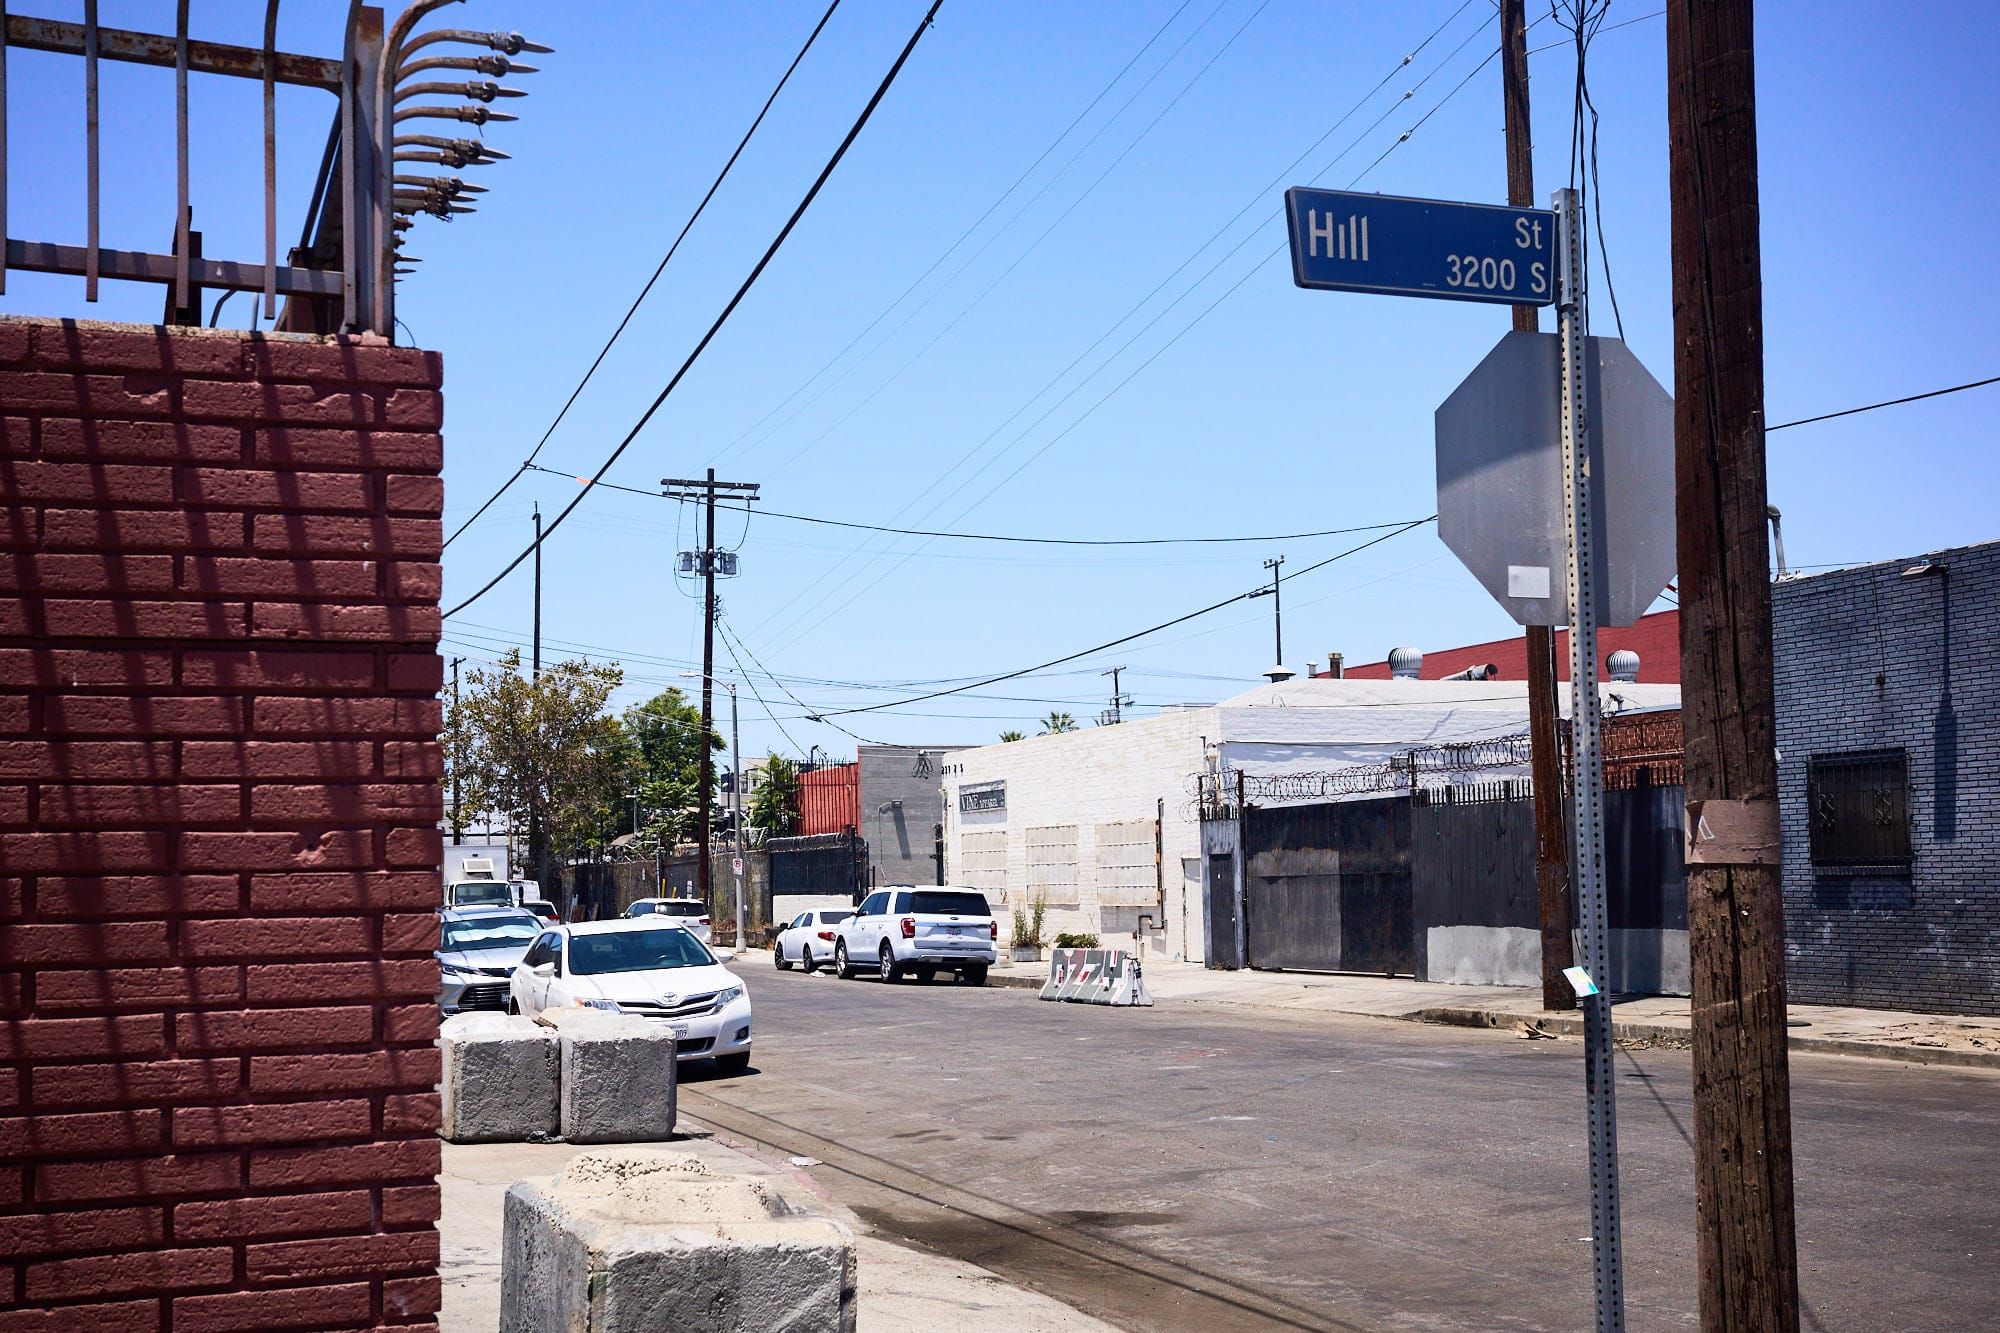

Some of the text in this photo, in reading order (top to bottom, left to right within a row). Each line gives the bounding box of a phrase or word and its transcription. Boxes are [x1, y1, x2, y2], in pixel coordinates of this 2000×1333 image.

[1309, 207, 1542, 262] Hill St
[1446, 254, 1546, 293] 3200 S
